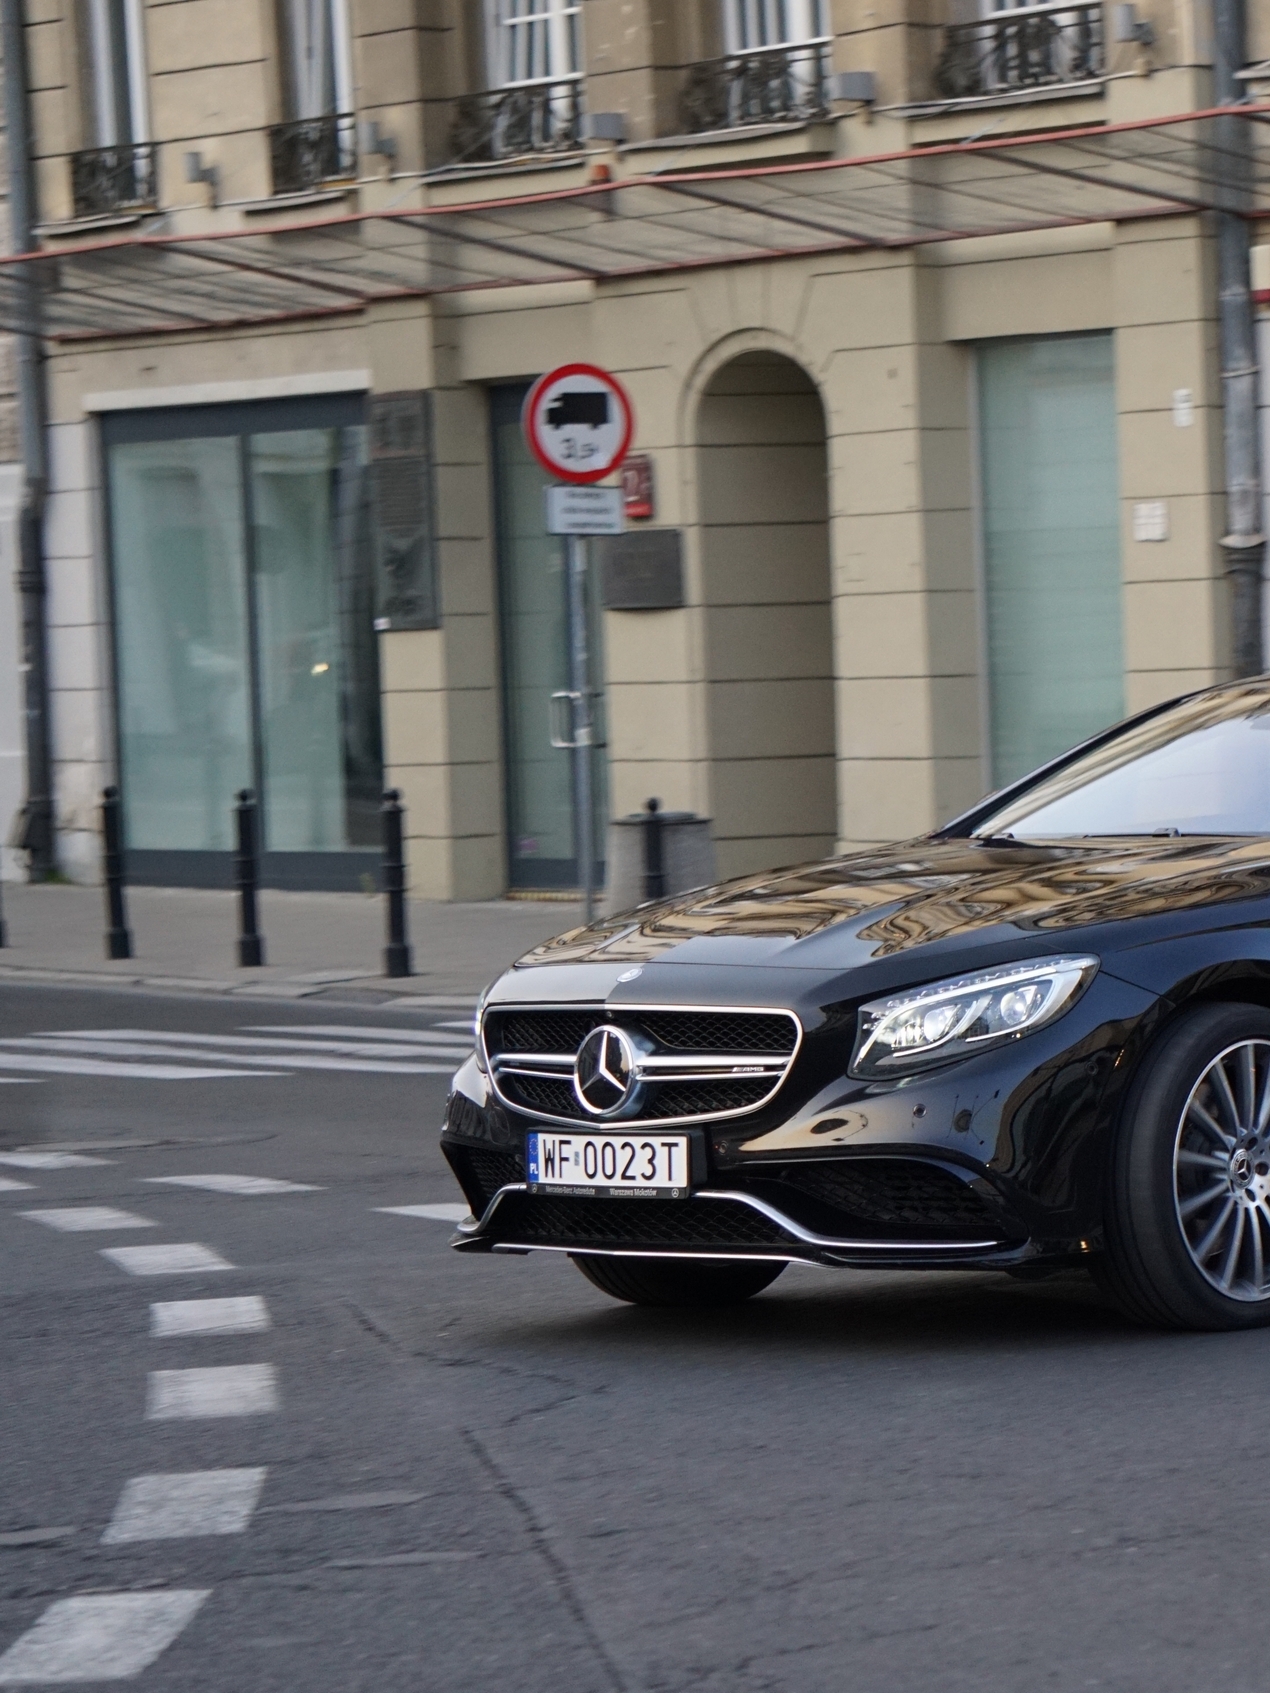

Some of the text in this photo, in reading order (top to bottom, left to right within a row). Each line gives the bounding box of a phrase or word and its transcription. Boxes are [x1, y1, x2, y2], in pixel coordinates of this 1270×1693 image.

[543, 1139, 679, 1181] WF 0023T
[529, 1163, 539, 1175] PL
[609, 1187, 634, 1196] Warszawa
[634, 1188, 657, 1197] Mokotów
